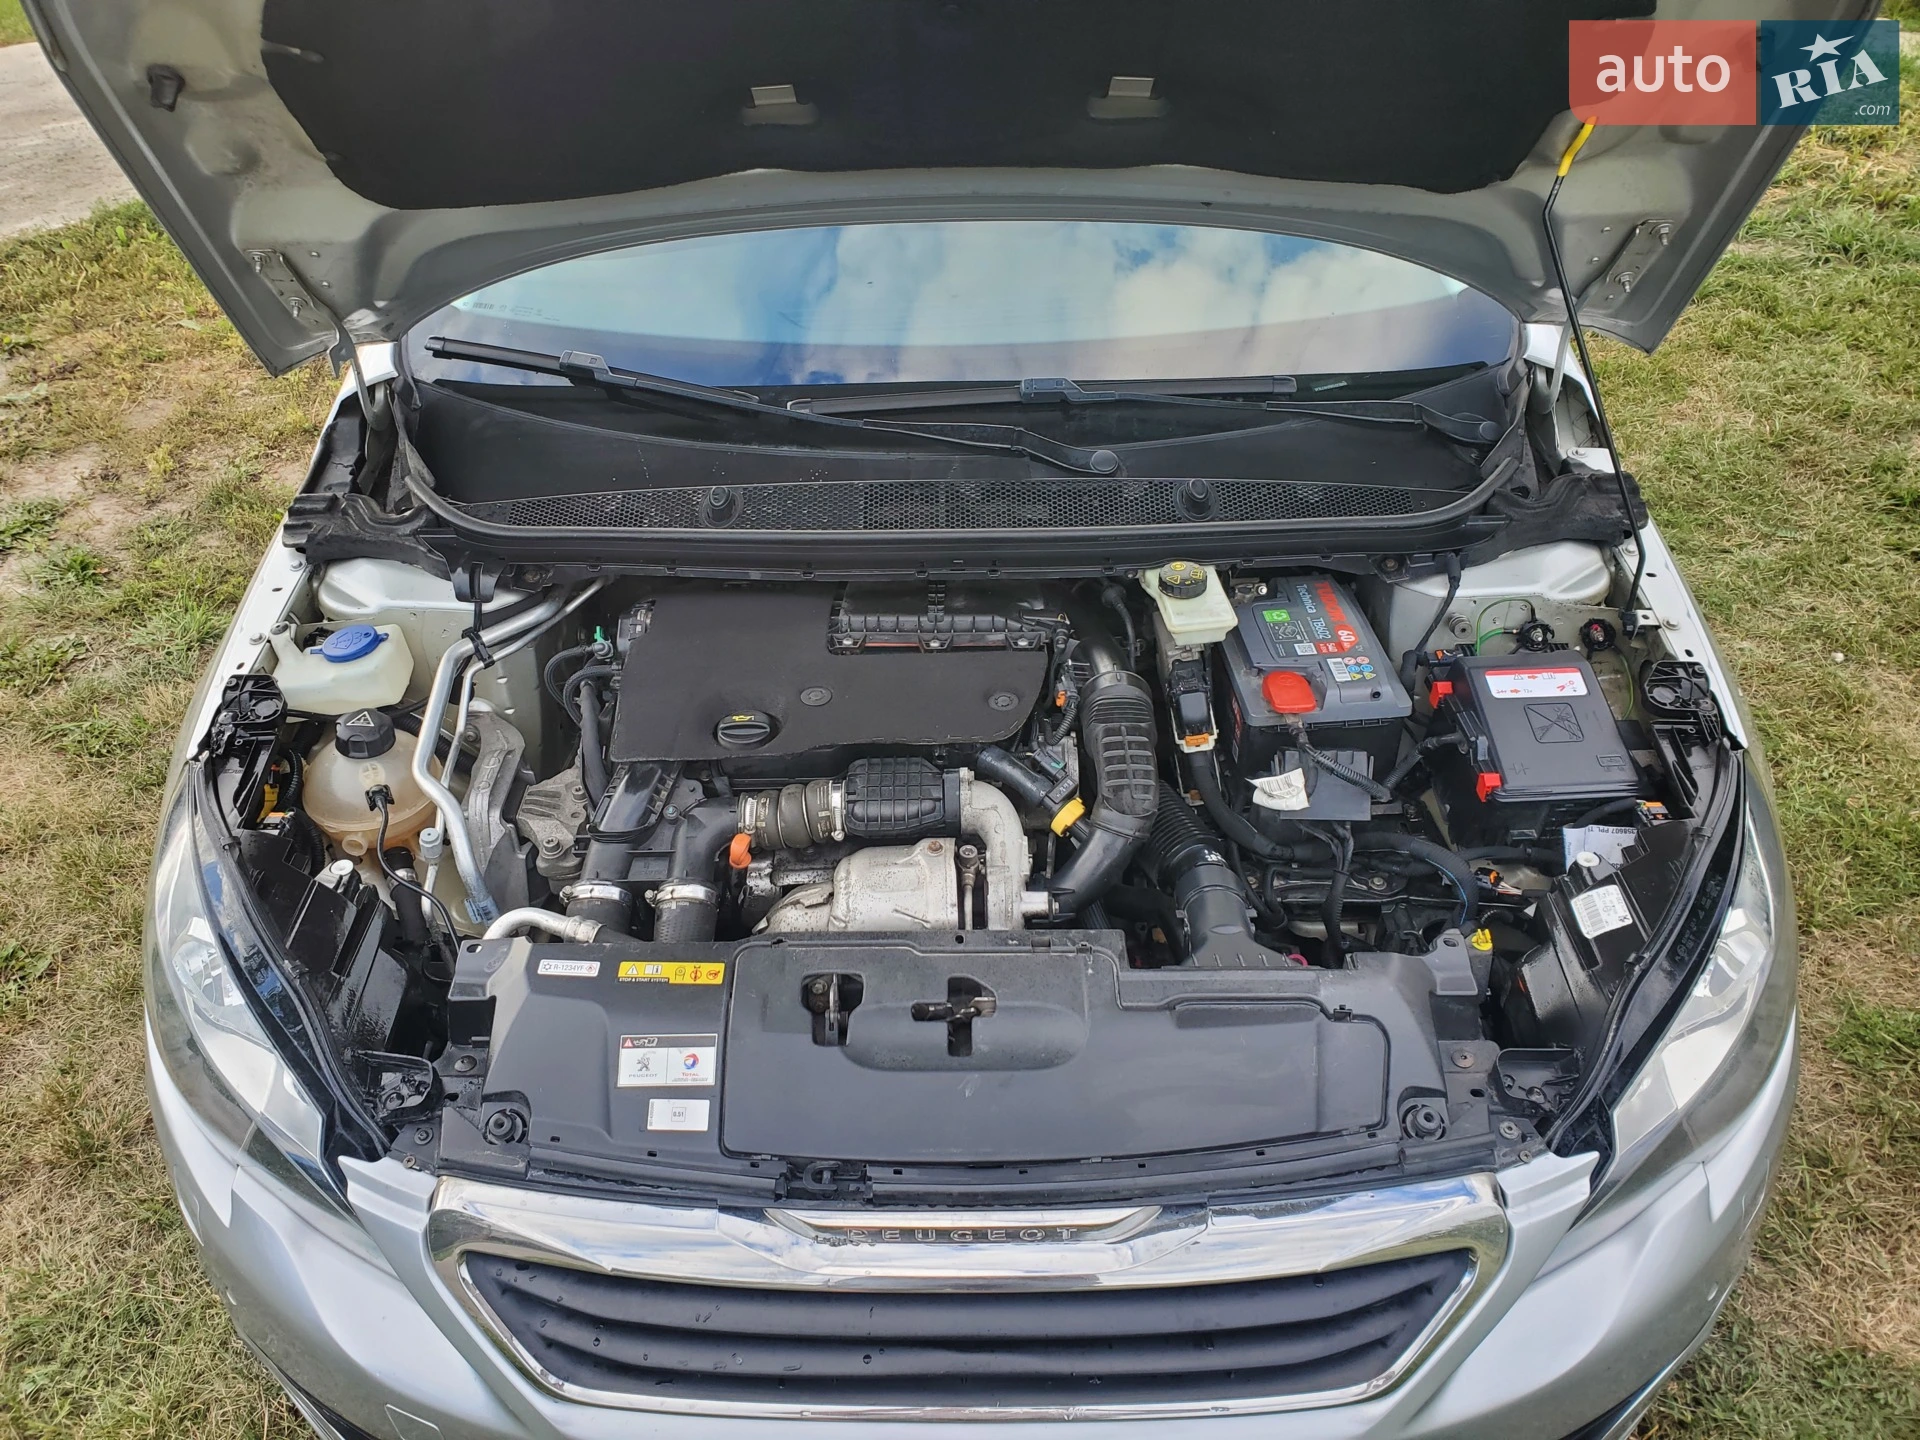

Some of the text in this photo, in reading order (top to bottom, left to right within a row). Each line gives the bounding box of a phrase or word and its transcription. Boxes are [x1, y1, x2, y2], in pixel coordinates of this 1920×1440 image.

[1296, 584, 1317, 613] Technica
[1316, 581, 1347, 622] TUDOR
[1312, 617, 1332, 640] TB602
[1338, 629, 1355, 642] 60
[1596, 826, 1610, 834] PPL
[553, 964, 585, 972] R-1234YF
[847, 1228, 1078, 1242] PEUGEOT
